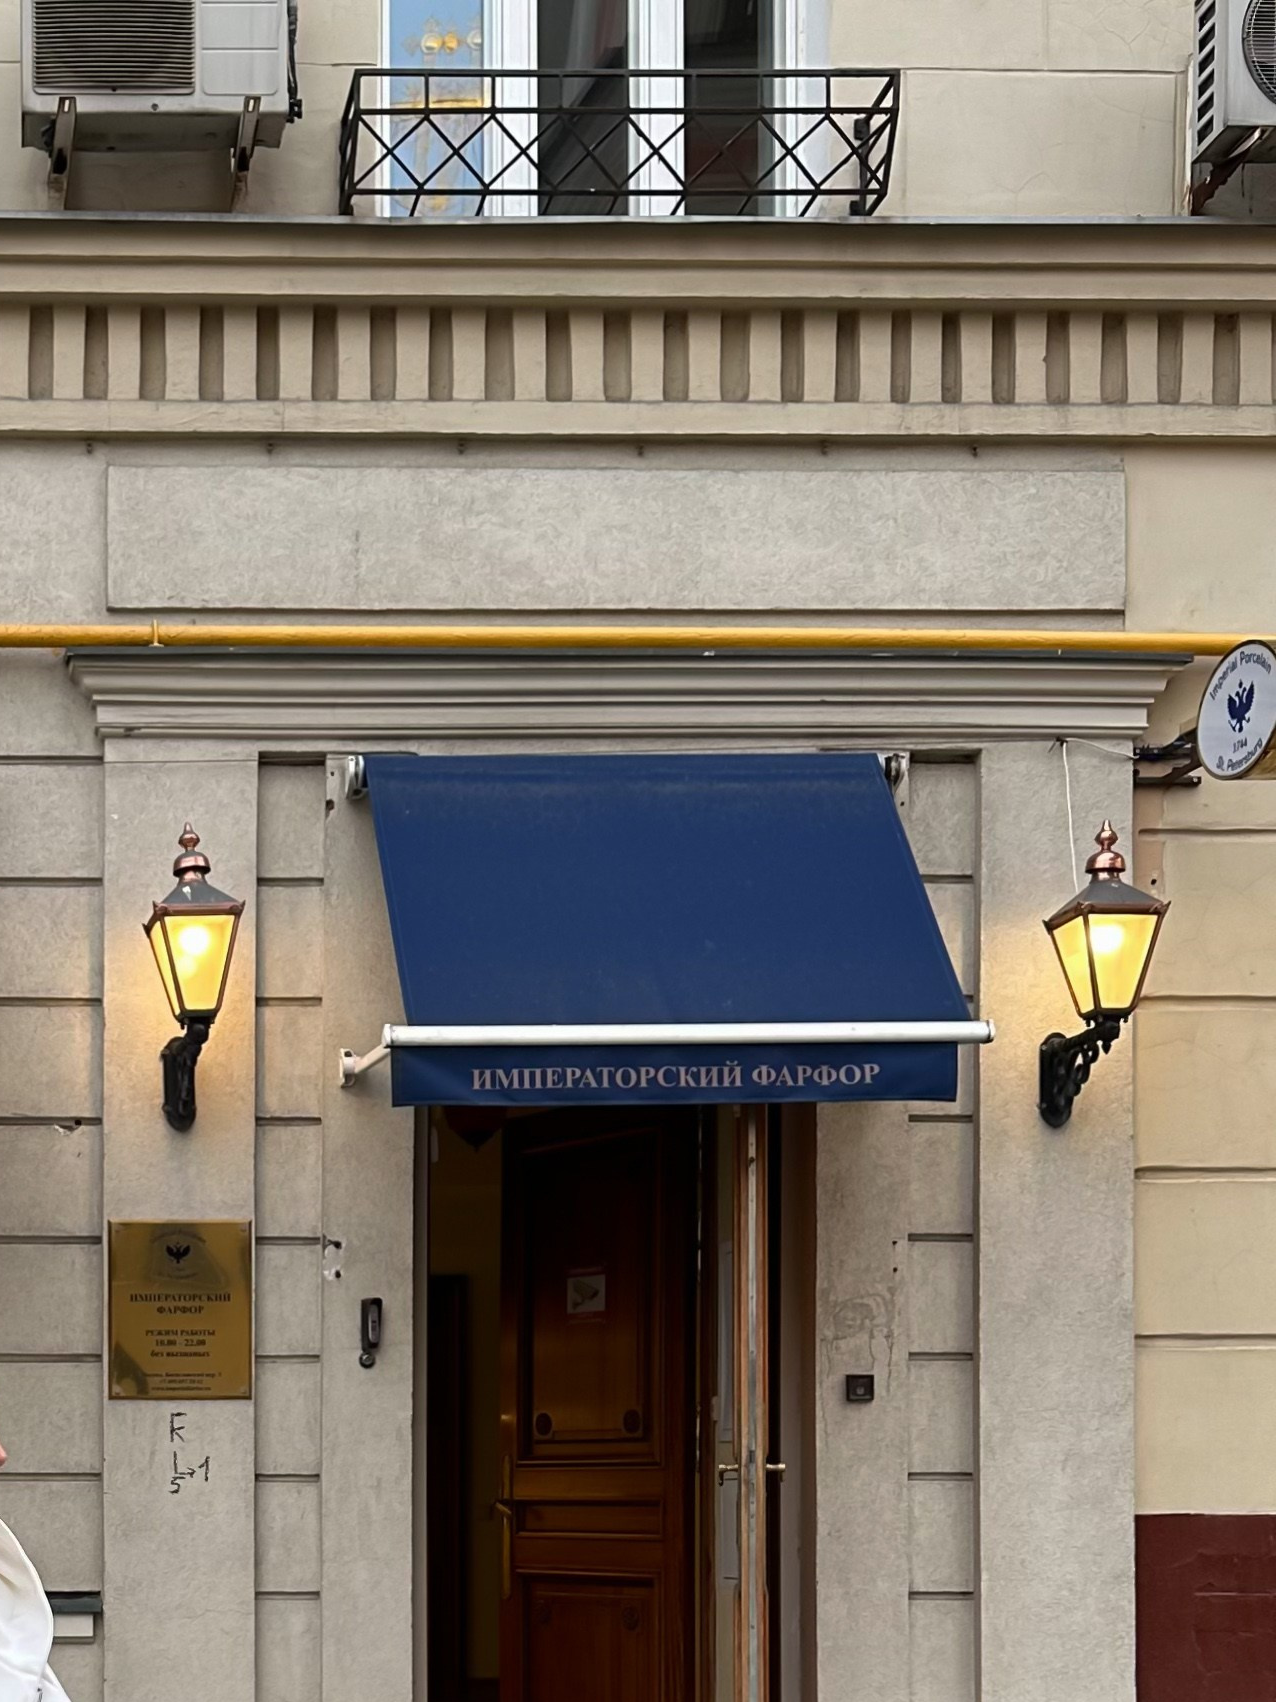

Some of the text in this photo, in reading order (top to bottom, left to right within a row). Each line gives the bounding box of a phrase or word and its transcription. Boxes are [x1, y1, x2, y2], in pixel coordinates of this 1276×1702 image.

[1209, 650, 1272, 701] Imperial Porcelain
[1227, 738, 1263, 771] Petersburg
[471, 1060, 881, 1090] ИМПЕРАТОРСКИЙ ФАРФОР
[129, 1292, 231, 1302] ИМПЕРАТОРСКИЙ
[156, 1305, 205, 1314] ФАРФОР
